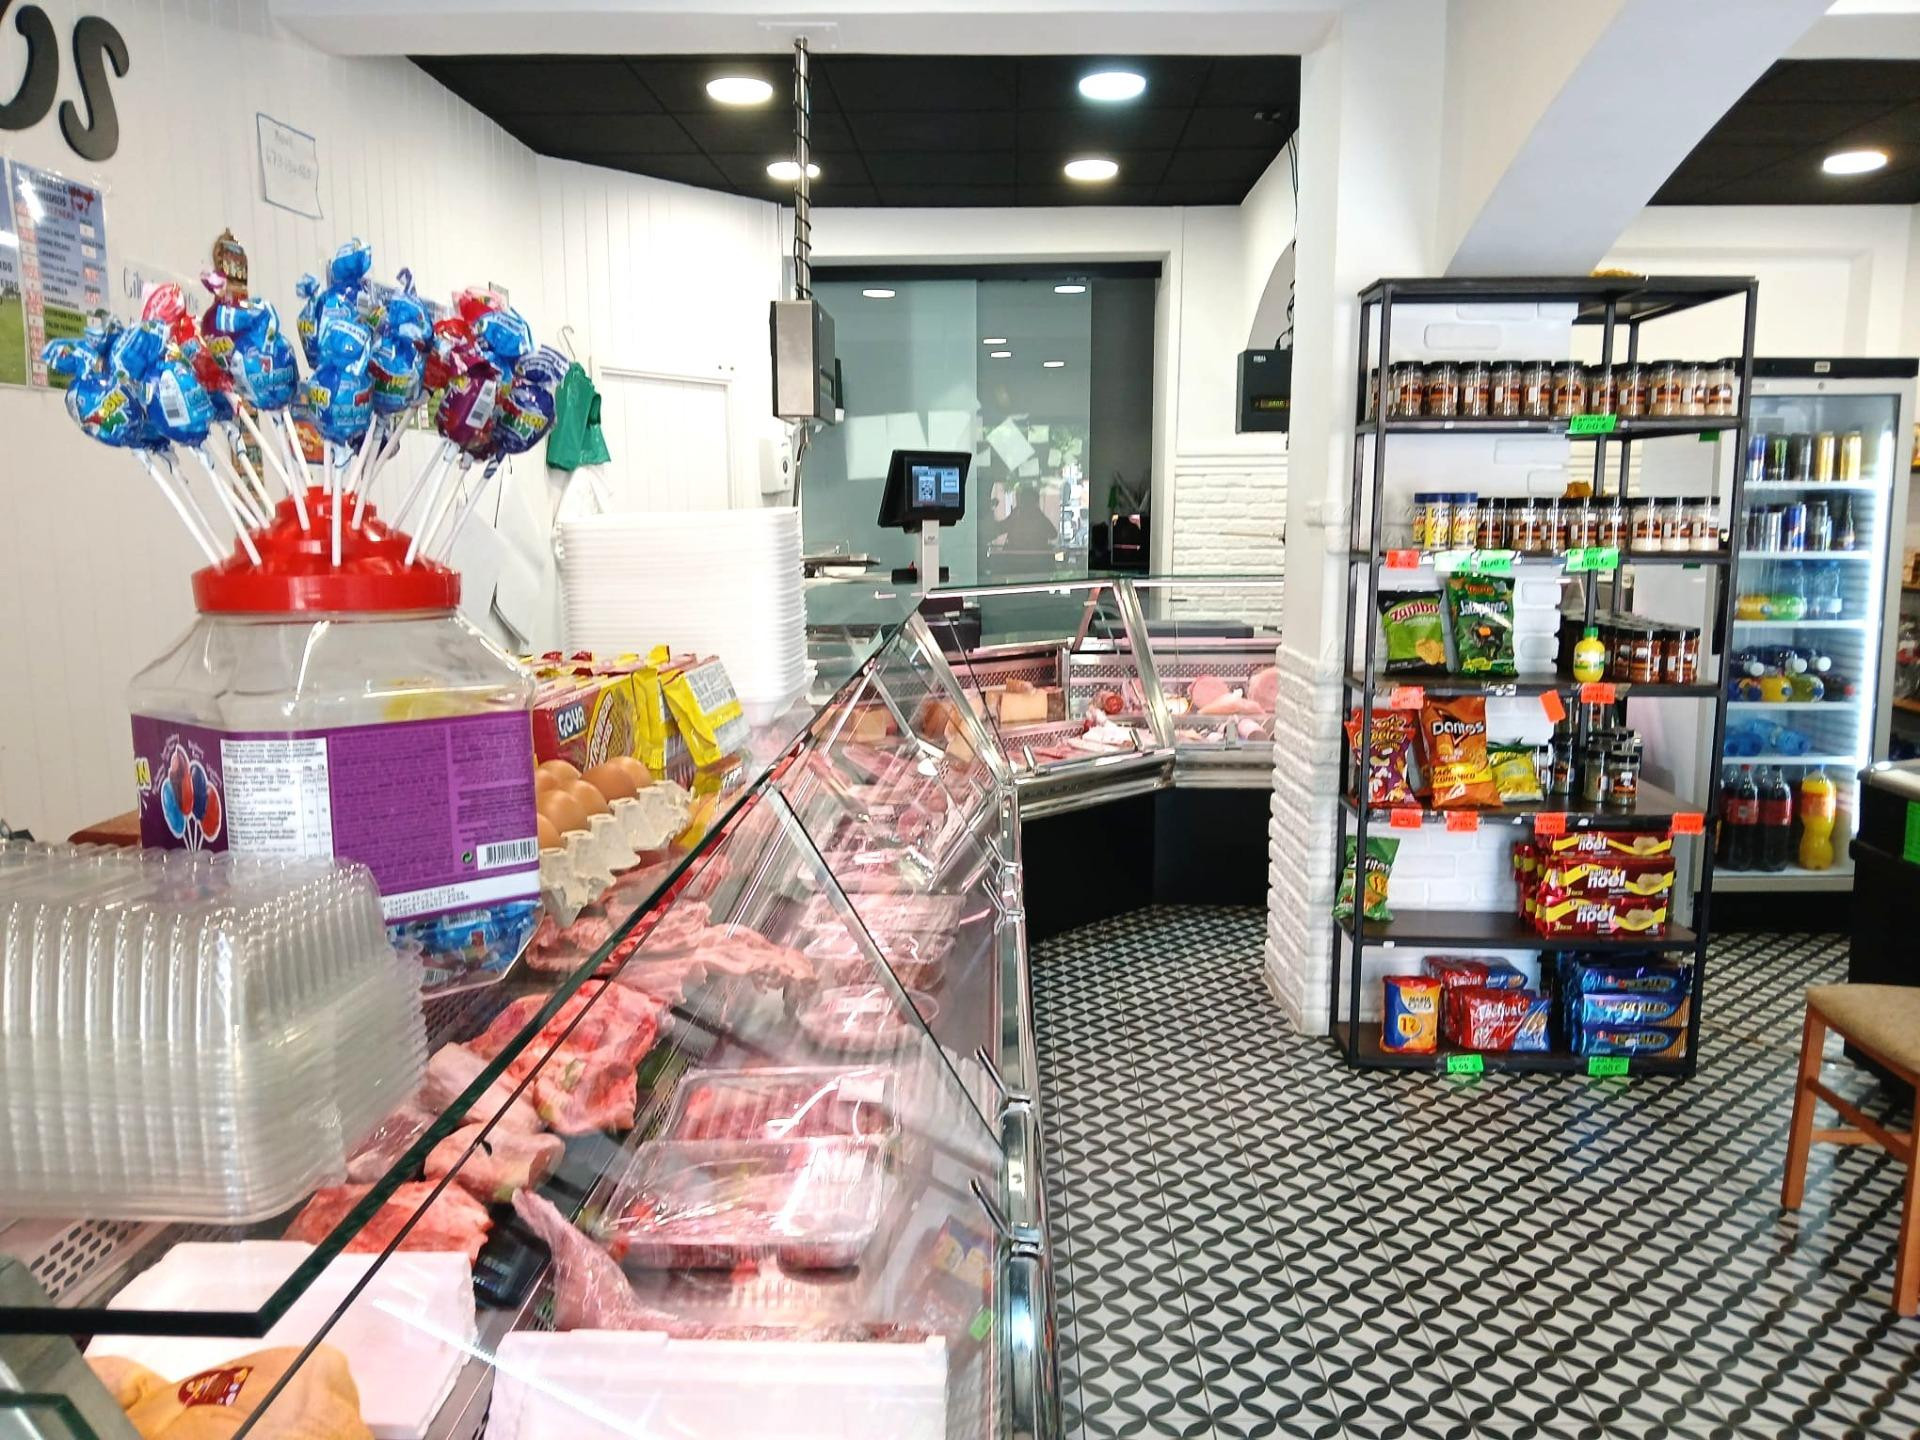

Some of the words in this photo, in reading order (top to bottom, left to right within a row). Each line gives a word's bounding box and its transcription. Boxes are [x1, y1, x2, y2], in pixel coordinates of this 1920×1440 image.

[558, 705, 586, 737] GOYA
[1432, 720, 1485, 736] Doritos
[1578, 836, 1607, 851] noel
[1587, 869, 1627, 888] noel
[1576, 905, 1616, 923] noel
[1399, 1017, 1416, 1032] 12
